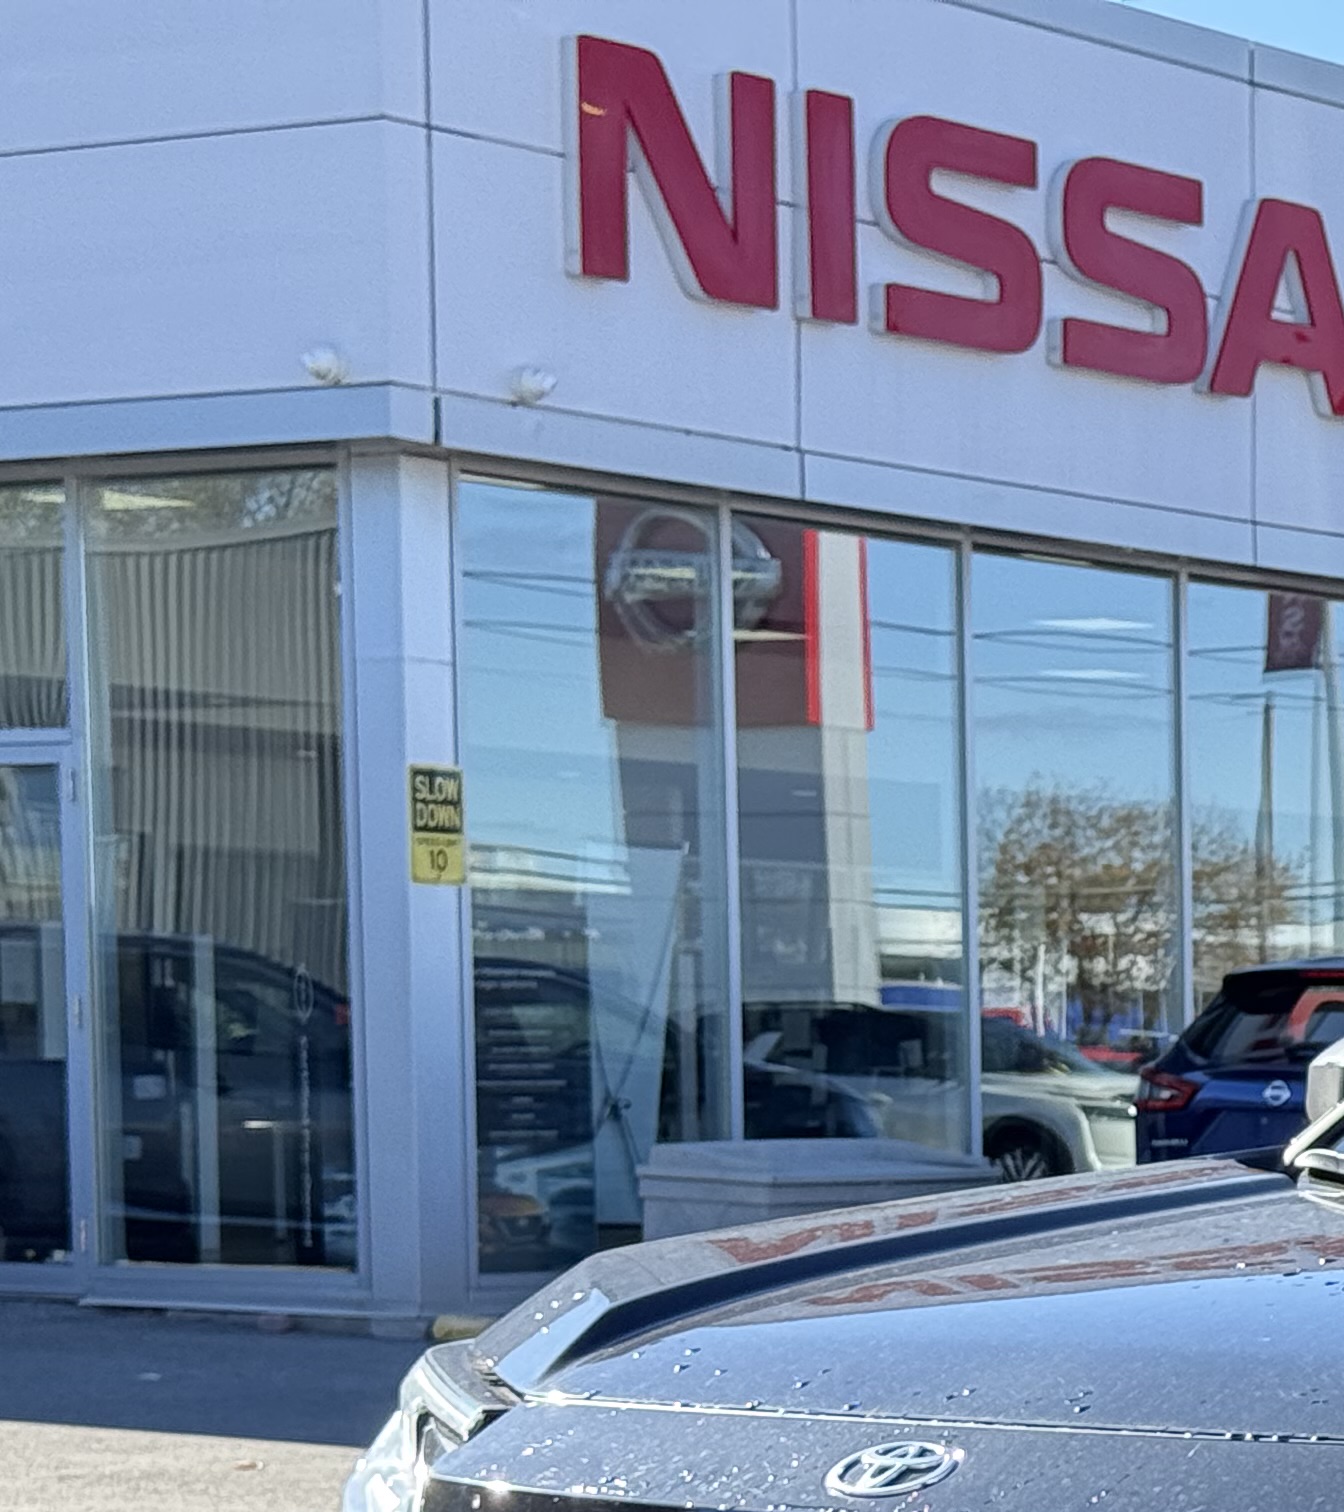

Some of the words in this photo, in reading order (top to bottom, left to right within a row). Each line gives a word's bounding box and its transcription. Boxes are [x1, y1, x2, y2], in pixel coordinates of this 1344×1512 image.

[415, 775, 459, 801] SLOW
[416, 804, 460, 828] DOWN
[430, 848, 448, 872] 10
